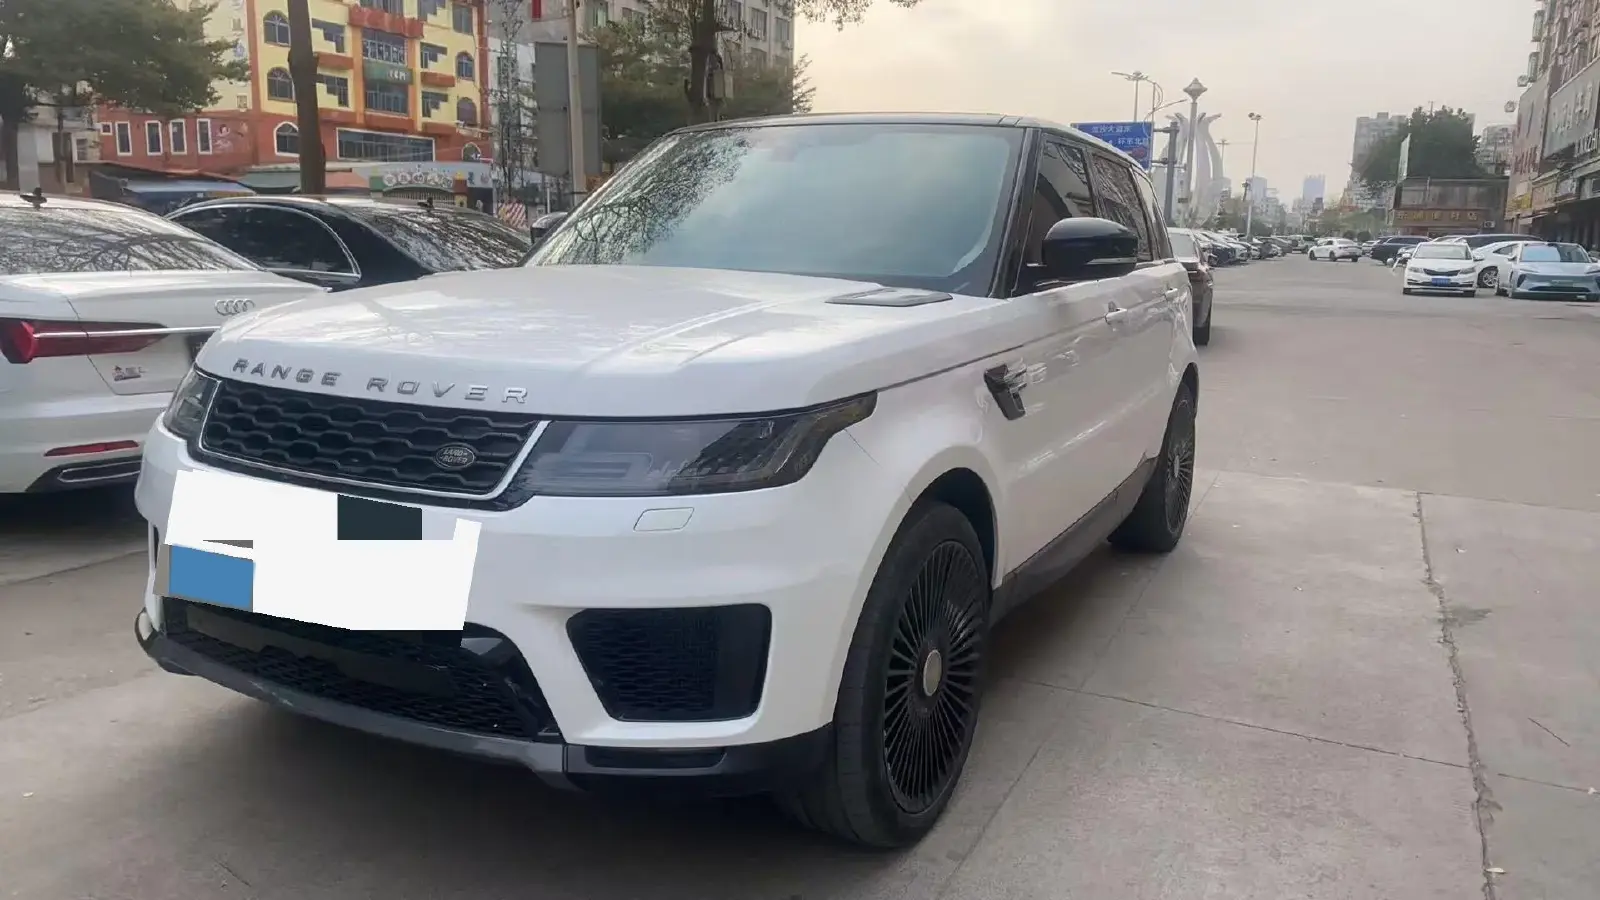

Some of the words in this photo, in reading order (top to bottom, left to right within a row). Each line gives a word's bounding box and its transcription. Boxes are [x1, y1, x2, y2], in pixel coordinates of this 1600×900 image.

[232, 357, 342, 387] RANGE
[366, 376, 529, 404] ROVER
[443, 448, 464, 456] LAND
[442, 456, 468, 464] ROVER
